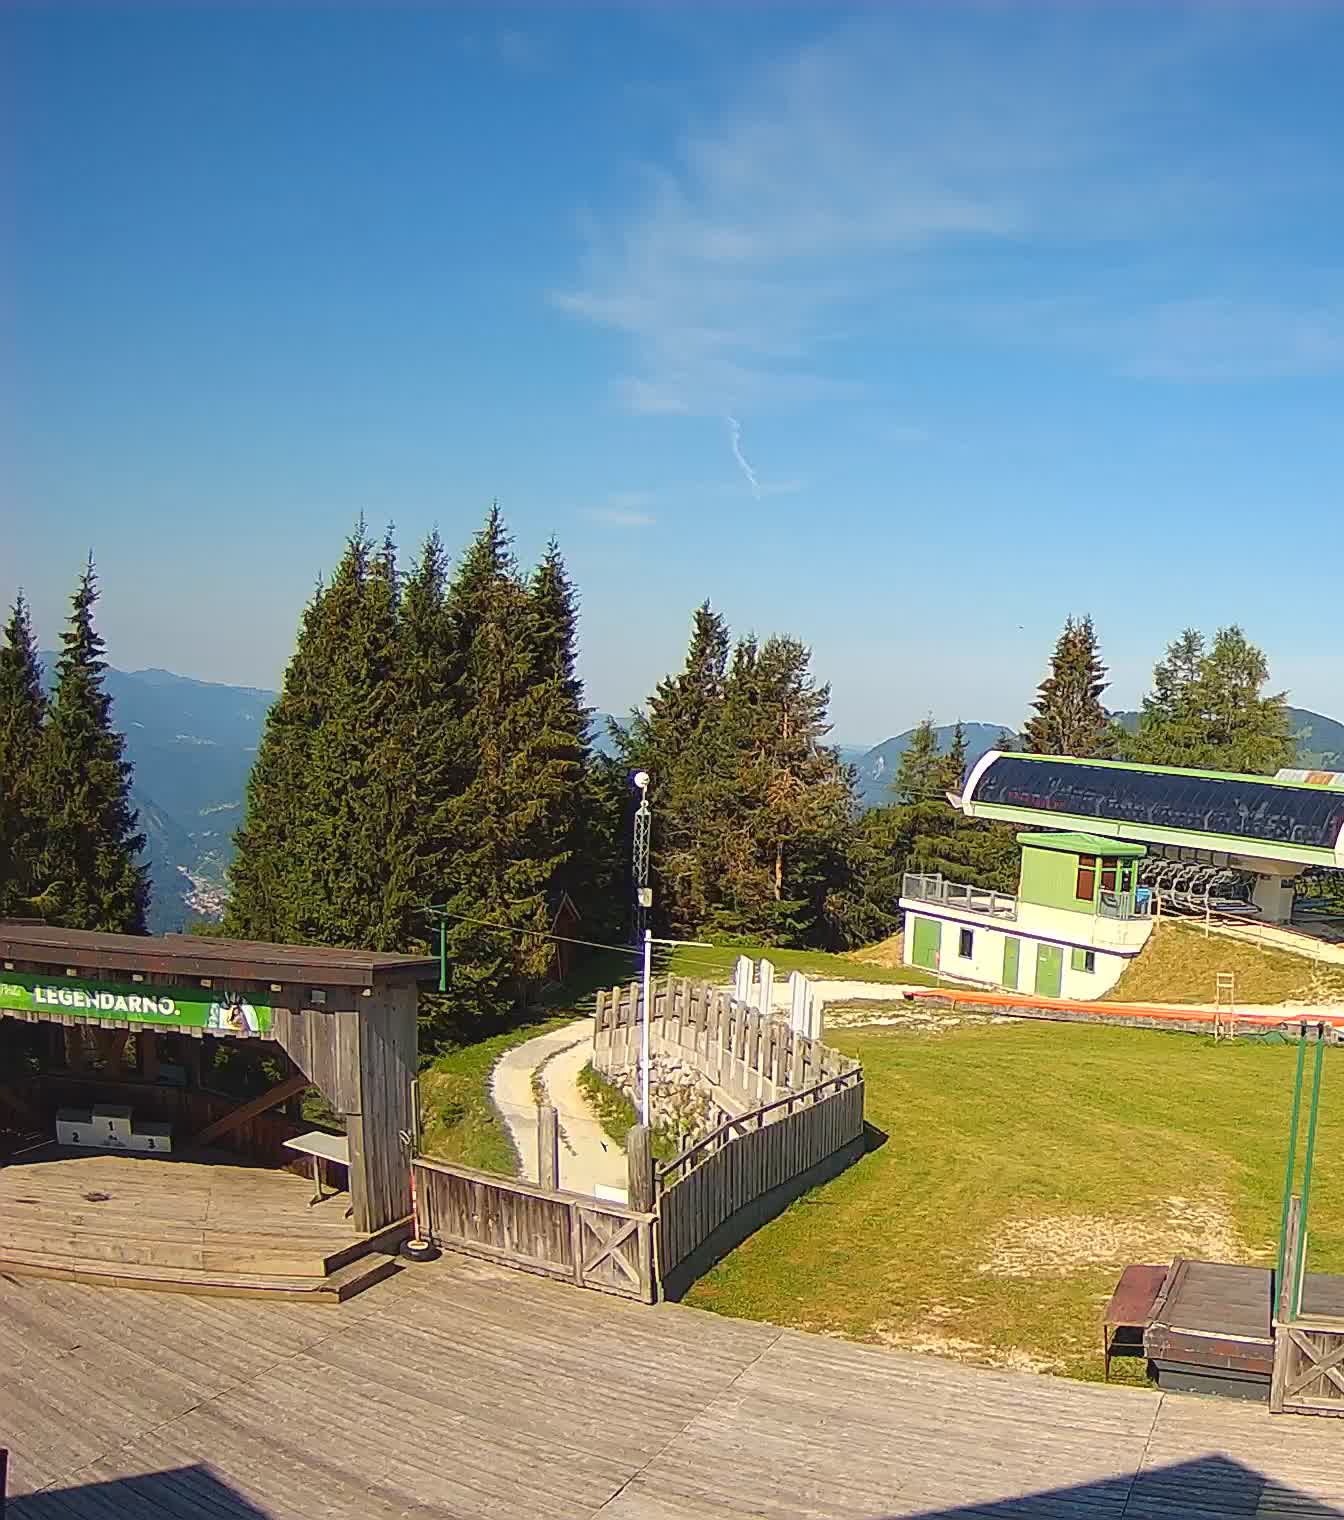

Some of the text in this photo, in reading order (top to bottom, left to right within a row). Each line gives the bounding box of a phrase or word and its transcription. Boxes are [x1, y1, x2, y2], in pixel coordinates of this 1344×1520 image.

[34, 985, 181, 1016] LEGENDARNO.
[72, 1132, 80, 1143] 2
[147, 1138, 156, 1149] 3
